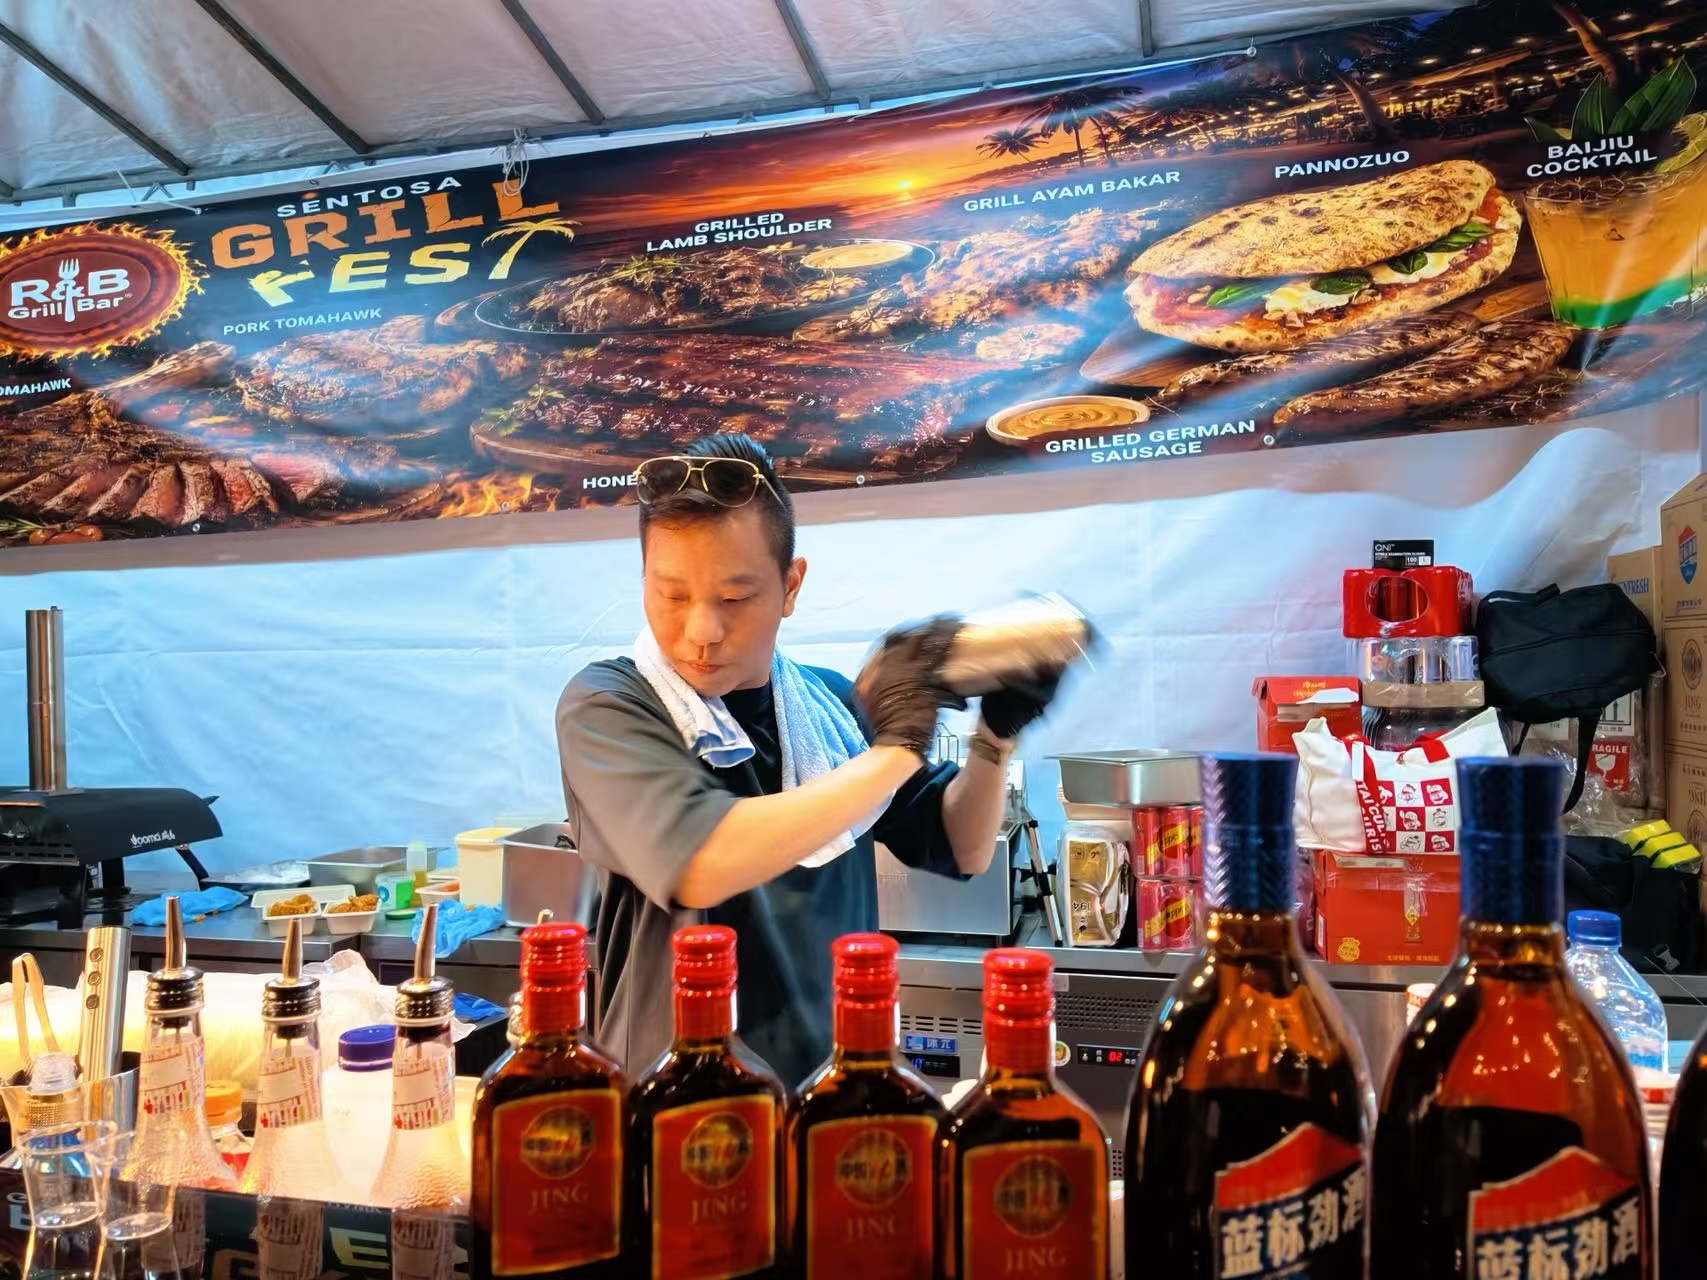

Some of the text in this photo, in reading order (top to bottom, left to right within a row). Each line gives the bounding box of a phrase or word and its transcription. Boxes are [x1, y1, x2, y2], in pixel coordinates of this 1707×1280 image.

[1547, 135, 1635, 159] BAIJIU
[1274, 150, 1410, 179] PANNOZUO
[1526, 149, 1658, 178] COCKTAIL
[277, 176, 463, 218] SENTOSA
[964, 171, 1181, 212] GRILL AYAM BAKAR
[211, 179, 561, 269] GRILL
[647, 219, 832, 252] LAMB SHOULDER
[695, 213, 784, 233] GRILLED
[11, 268, 130, 307] R&B
[8, 297, 124, 318] Grill Bar
[223, 308, 383, 335] PORK TOMAHAWK
[1045, 420, 1256, 453] GRILLED GERMAN
[1091, 441, 1203, 463] SAUSAGE
[583, 475, 637, 489] HONE
[1592, 744, 1628, 754] RAGILE
[528, 1183, 589, 1215] JING
[690, 1196, 747, 1226] JING
[1005, 1246, 1068, 1275] JING
